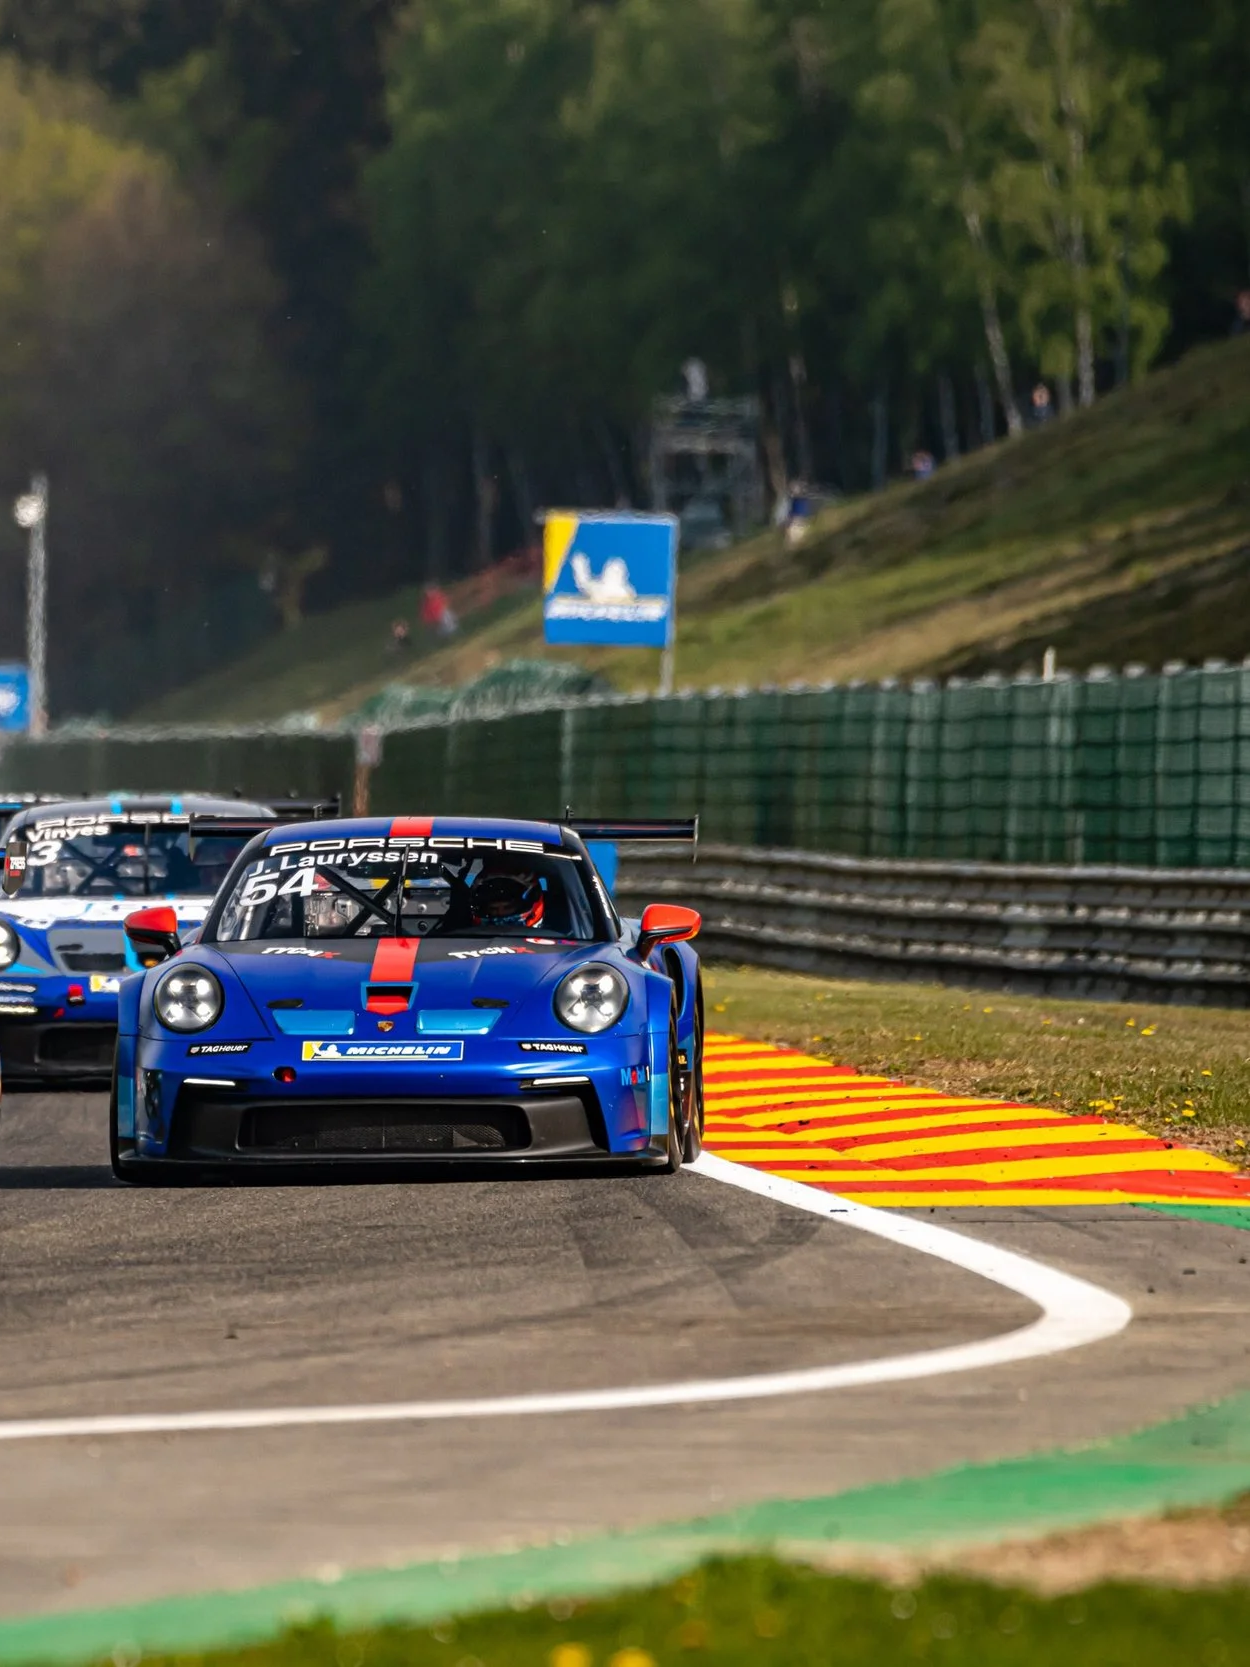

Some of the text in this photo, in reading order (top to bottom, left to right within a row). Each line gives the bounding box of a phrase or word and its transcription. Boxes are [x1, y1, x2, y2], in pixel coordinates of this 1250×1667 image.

[26, 824, 111, 842] Vinyes
[27, 841, 62, 866] 3
[270, 837, 544, 856] PORSCHE
[249, 851, 438, 877] J. Lauryssen
[240, 867, 319, 907] 54
[345, 1046, 452, 1055] MICHELIN
